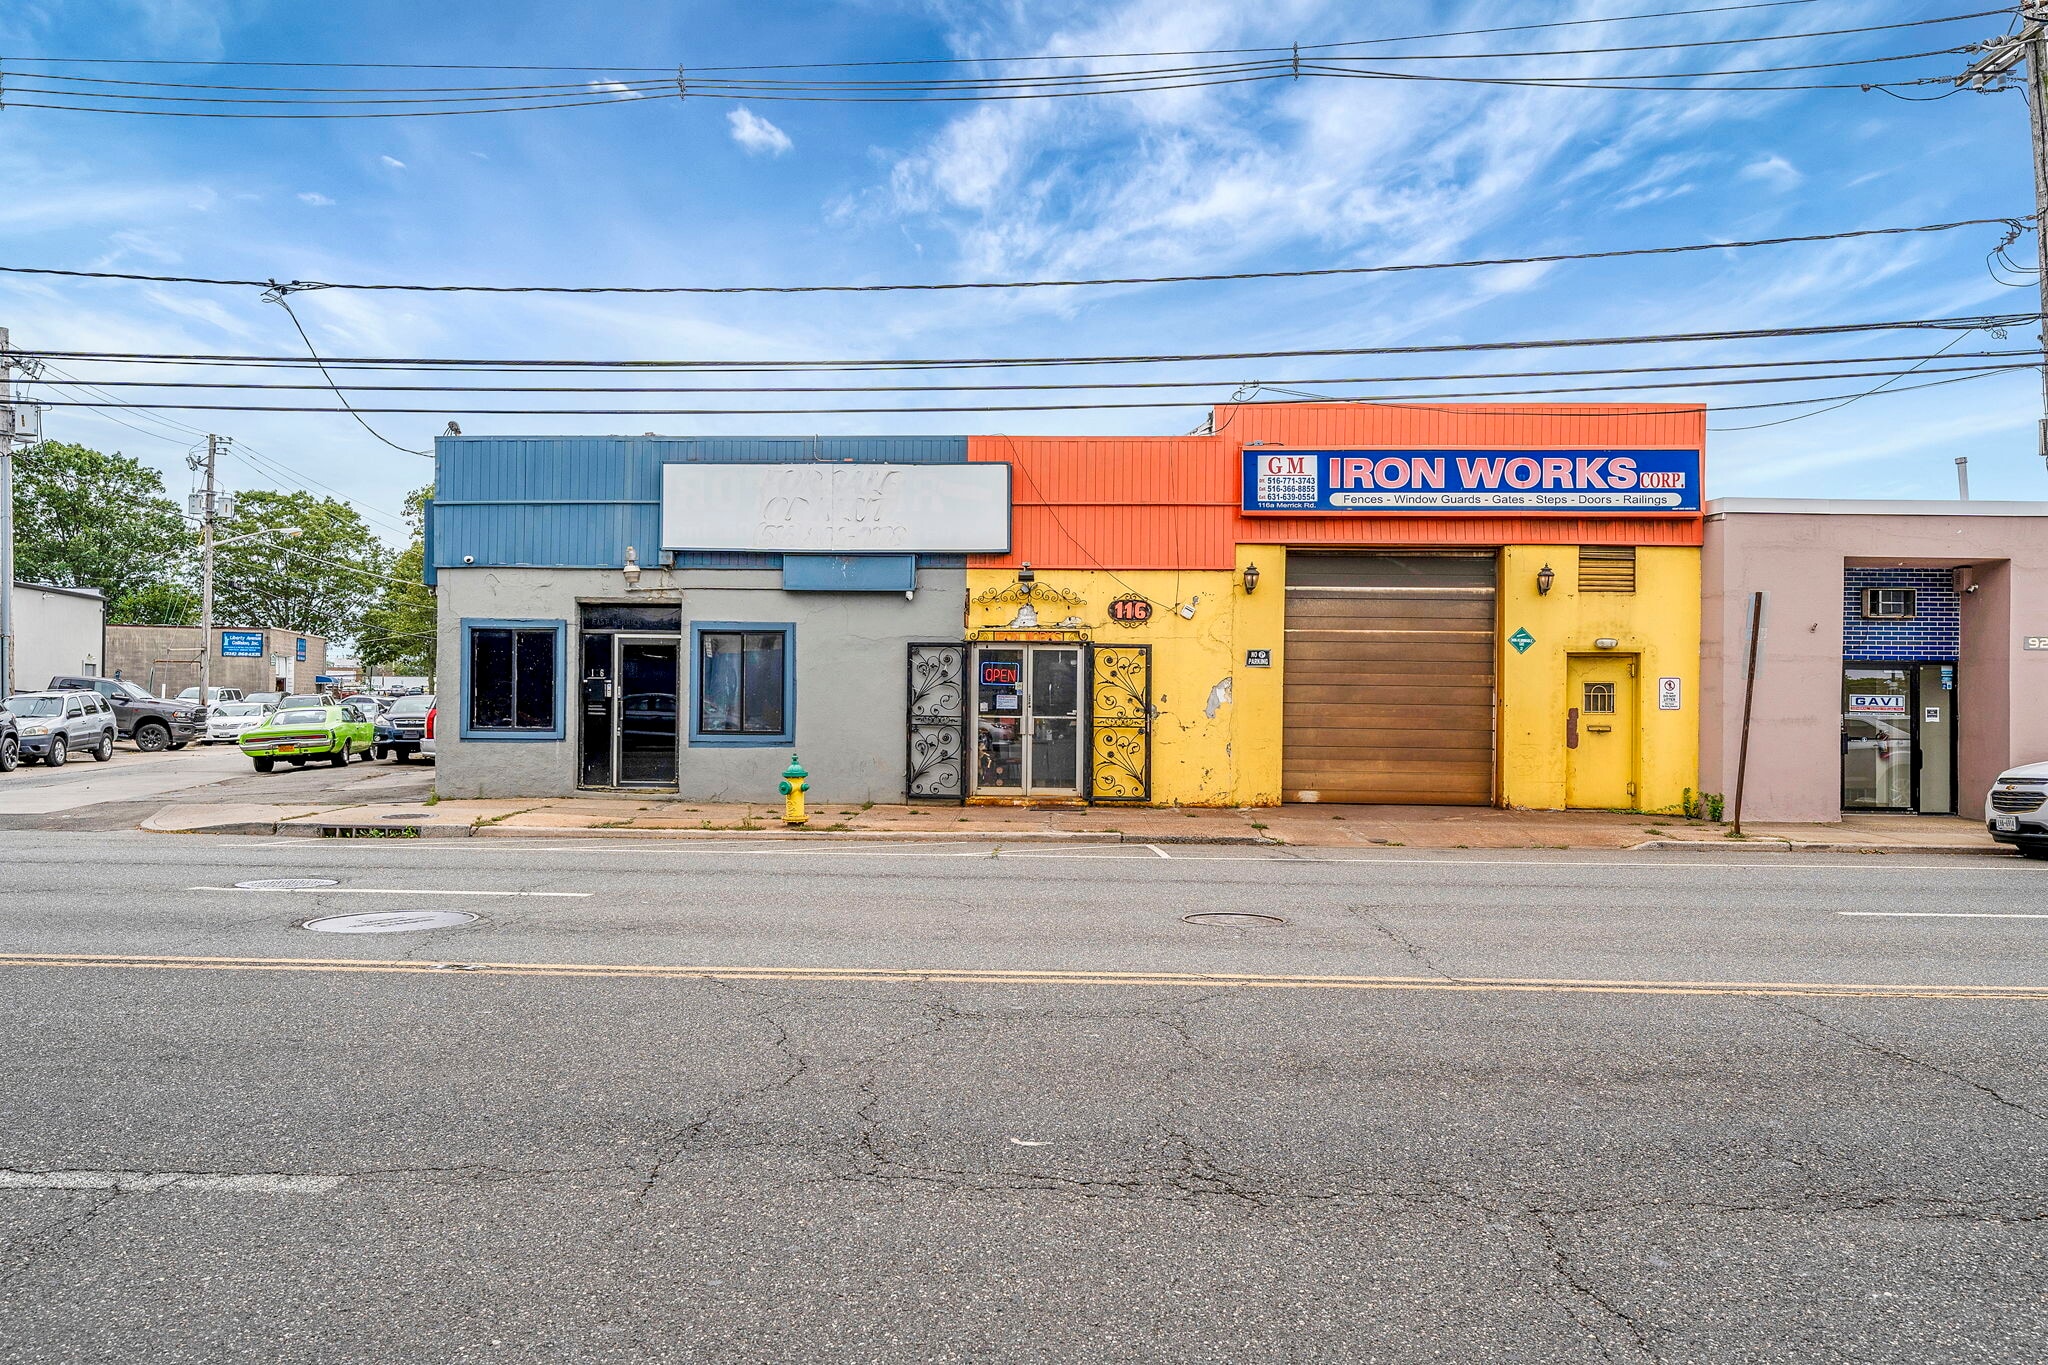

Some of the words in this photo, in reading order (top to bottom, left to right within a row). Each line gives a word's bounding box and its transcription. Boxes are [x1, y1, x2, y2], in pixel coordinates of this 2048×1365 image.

[1329, 457, 1445, 489] IRON
[1456, 457, 1638, 489] WORKS
[1641, 473, 1685, 488] CORP.
[1267, 477, 1316, 485] 516-771-3743
[1343, 495, 1383, 504] Fences
[1394, 495, 1438, 504] Window
[1441, 495, 1481, 504] Guards
[1492, 495, 1524, 504] Gates
[1536, 495, 1568, 506] Steps
[1579, 495, 1612, 504] Doors
[1624, 495, 1668, 506] Railings
[1115, 602, 1147, 619] 116
[985, 668, 1017, 682] OPEN
[1855, 697, 1899, 706] GAVI
